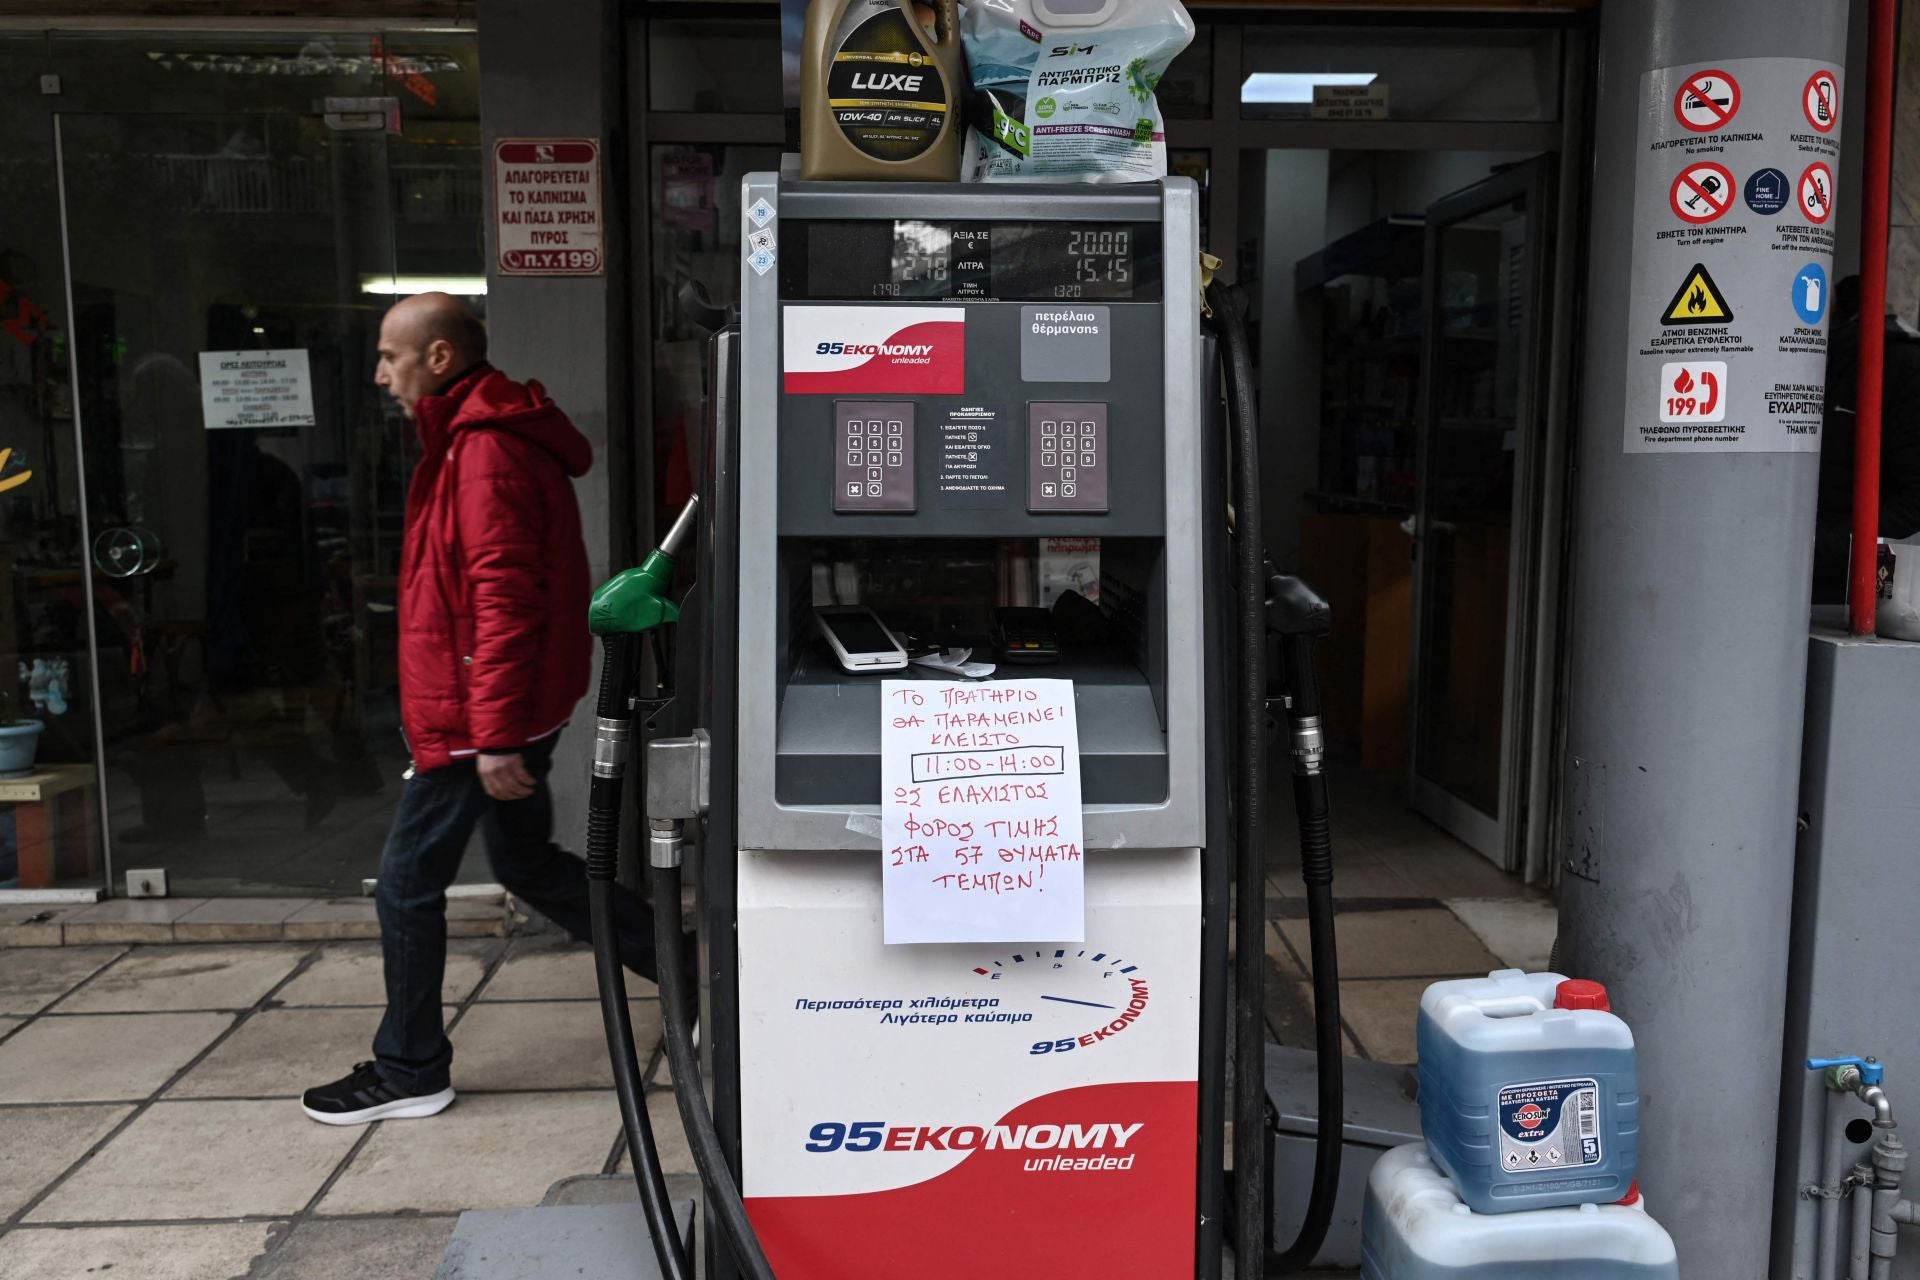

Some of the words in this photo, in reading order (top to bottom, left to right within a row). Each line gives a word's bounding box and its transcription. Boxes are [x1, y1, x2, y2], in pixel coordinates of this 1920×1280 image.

[1021, 25, 1042, 41] CARE
[1040, 65, 1121, 79] ΑΝΤΙΠΑΓΩΤΙΚΟ
[851, 72, 923, 92] LUXE
[1038, 74, 1121, 87] ΠΑΡΜΠΡΙΖ
[839, 113, 882, 121] 10W-40
[1036, 125, 1083, 135] ANTI-FREEZE
[1084, 125, 1131, 138] SCREENWASH
[1650, 135, 1707, 151] ΑΠΑΓΟΡΕΥΕΤΑΙ
[1708, 135, 1719, 143] ΤΟ
[1720, 133, 1764, 142] ΚΑΠΝΙΣΜΑ
[1790, 134, 1814, 143] ΚΛΕΙΣΤΕ
[1685, 147, 1695, 155] No
[1696, 145, 1725, 155] smoking
[1798, 144, 1814, 152] Switch
[505, 170, 590, 184] ΑΠΑΓΟΡΕΥΕΤΑΙ
[509, 191, 524, 204] ΤΟ
[528, 191, 587, 204] ΚΑΠΝΙΣΜΑ
[502, 211, 522, 224] ΚΑΙ
[525, 211, 554, 224] ΠΑΣΑ
[558, 211, 596, 224] ΧΡΗΣΗ
[953, 231, 976, 240] ΑΞΙΑ
[977, 231, 990, 240] ΣΕ
[1657, 229, 1686, 240] ΣΒΗΣΤΕ
[1687, 227, 1703, 237] ΤΟΝ
[1705, 225, 1747, 235] ΚΙΝΗΤΗΡΑ
[1776, 225, 1809, 234] ΚΑΤΕΒΕΙΤΕ
[531, 231, 569, 244] ΠΥΡΟΣ
[1068, 231, 1128, 255] 20.00
[1677, 238, 1691, 246] Turn
[1692, 237, 1702, 245] off
[1703, 236, 1724, 247] engine
[1782, 234, 1798, 242] ΠΡΙΝ
[1799, 235, 1810, 243] ΤΟΝ
[968, 241, 975, 250] €
[957, 261, 985, 271] ΛΙΤΡΑ
[1077, 258, 1127, 282] 15.15
[1035, 311, 1095, 323] πετρέλαιο
[1661, 328, 1686, 338] ΑΤΜΟΙ
[1687, 327, 1729, 336] ΒΕΝΖΙΝΗΣ
[1793, 327, 1811, 336] ΧΡΗΣΗ
[1650, 337, 1695, 347] ΕΞΑΙΡΕΤΙΚΑ
[1697, 335, 1742, 345] ΕΥΦΛΕΚΤΟΙ
[1639, 348, 1663, 356] Gasoline
[1687, 346, 1719, 355] extremely
[1720, 345, 1754, 353] flammable
[891, 357, 931, 365] unleaded
[1775, 383, 1791, 391] ΕΙΝΑΙ
[1792, 384, 1806, 392] ΧΑΡΑ
[1764, 392, 1809, 401] ΕΞΥΠΗΡΕΤΟΥΜΕ
[1667, 397, 1697, 416] 199
[1640, 426, 1680, 435] ΤΗΛΕΦΩΝΟ
[1682, 425, 1746, 434] ΠΥΡΟΣΒΕΣΤΙΚΗΣ
[1786, 425, 1808, 434] THANK
[1644, 435, 1657, 443] Fire
[1657, 435, 1692, 444] department
[1693, 435, 1714, 444] phone
[1715, 434, 1739, 442] number
[893, 689, 924, 706] ΤΟ
[940, 688, 1037, 709] ΠΡΑΤΗΡΙΟ
[893, 715, 925, 729] ΘΑ
[934, 706, 1063, 729] ΠΑΡΑΜΕΙΝΕΙ
[931, 732, 1019, 747] ΚΛΕΙΣΤΟ
[938, 783, 1048, 805] ΕΛΑΧΙΣΤΟΣ
[985, 815, 1059, 839] ΤΙΜΗΣ
[891, 845, 930, 866] ΣΤΑ
[955, 845, 983, 865] 57
[998, 843, 1081, 863] ΘΥΜΑΤΑ
[990, 972, 1002, 980] E
[1104, 971, 1114, 979] F
[795, 998, 904, 1012] Περισσότερα
[909, 996, 999, 1011] χιλιόμετρα
[880, 1012, 958, 1026] Λιγότερο
[964, 1011, 1033, 1024] καύσιμο
[1515, 1090, 1558, 1099] ΠΡΟΣΘΕΤΑ
[1518, 1130, 1544, 1138] extra
[1583, 1139, 1596, 1154] 5
[1023, 1154, 1136, 1171] unleaded
